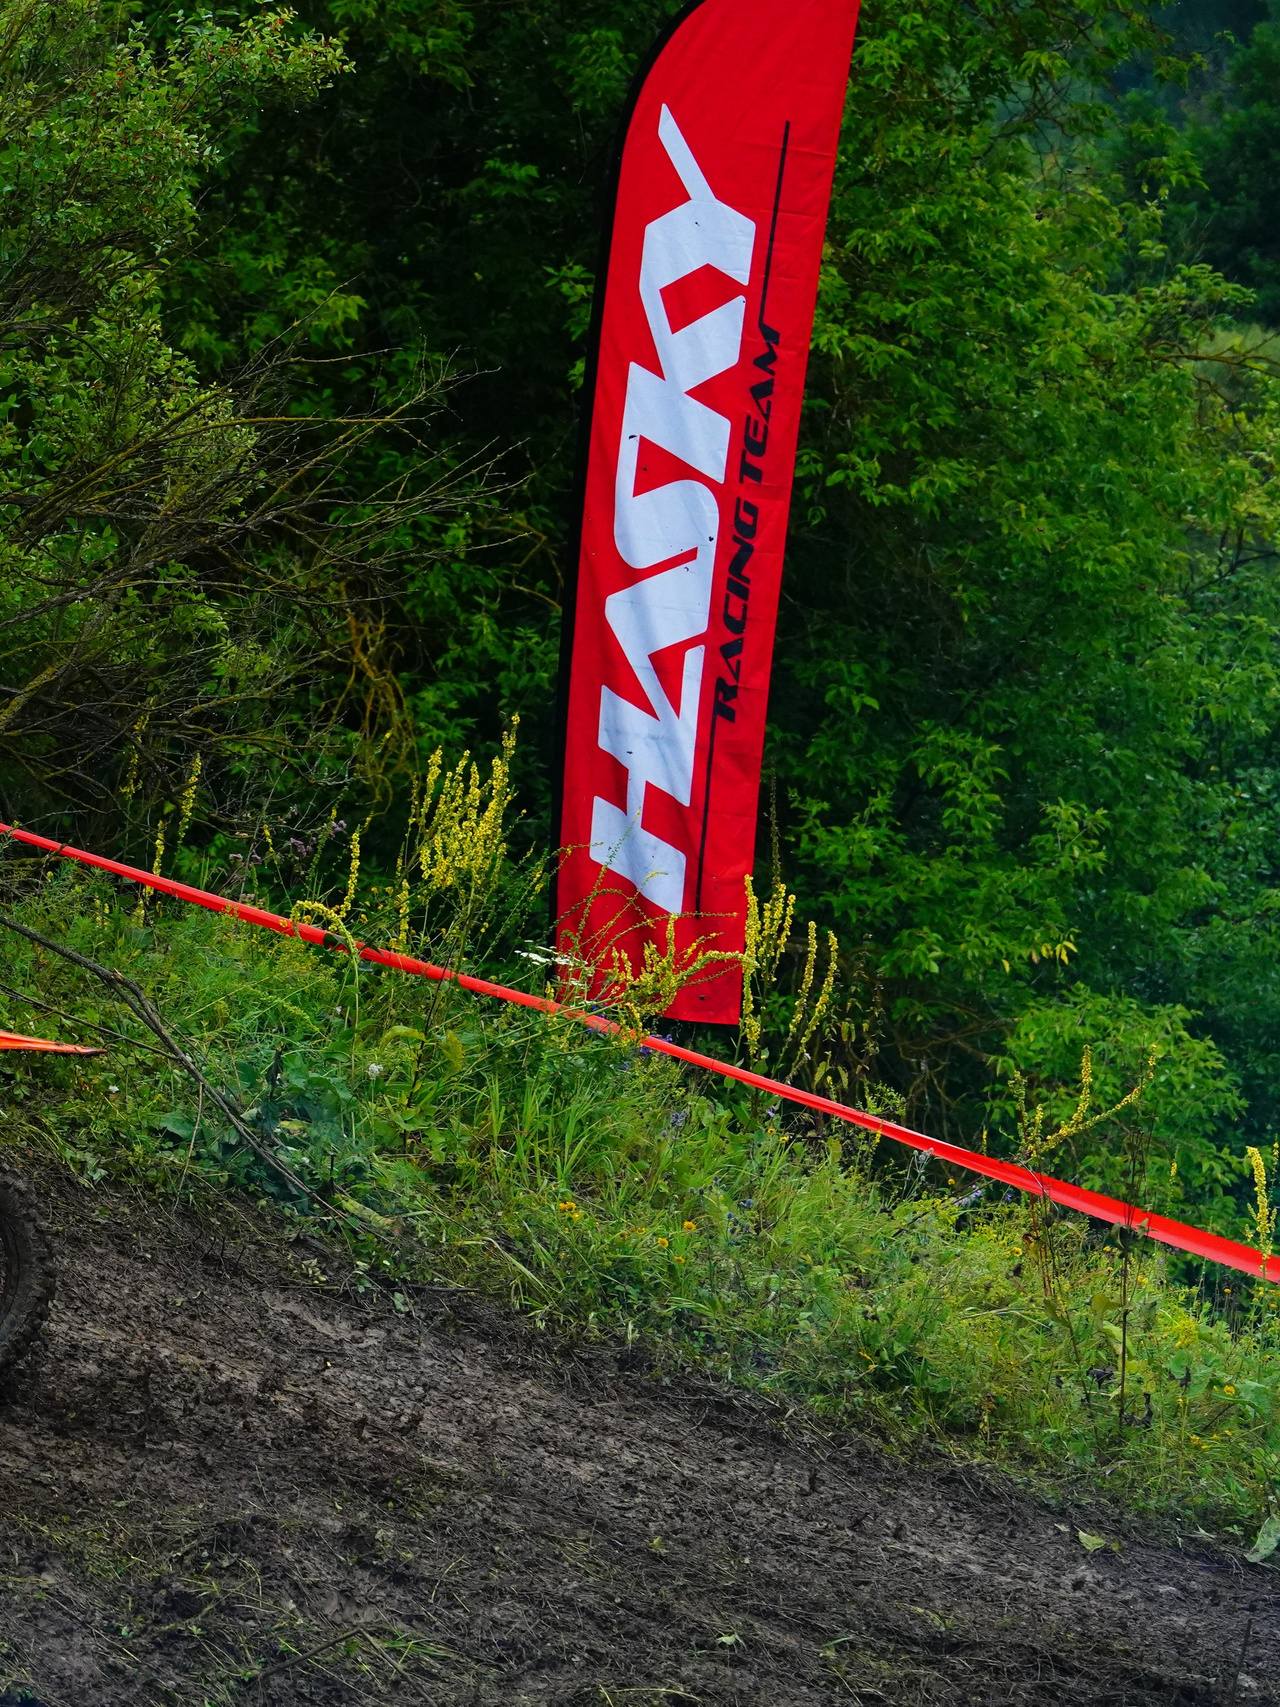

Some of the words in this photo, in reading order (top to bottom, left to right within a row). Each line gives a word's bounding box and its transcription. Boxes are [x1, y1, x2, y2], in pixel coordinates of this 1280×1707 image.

[590, 102, 757, 915] HASKY
[715, 497, 759, 724] RACING
[739, 320, 780, 484] TEAM
